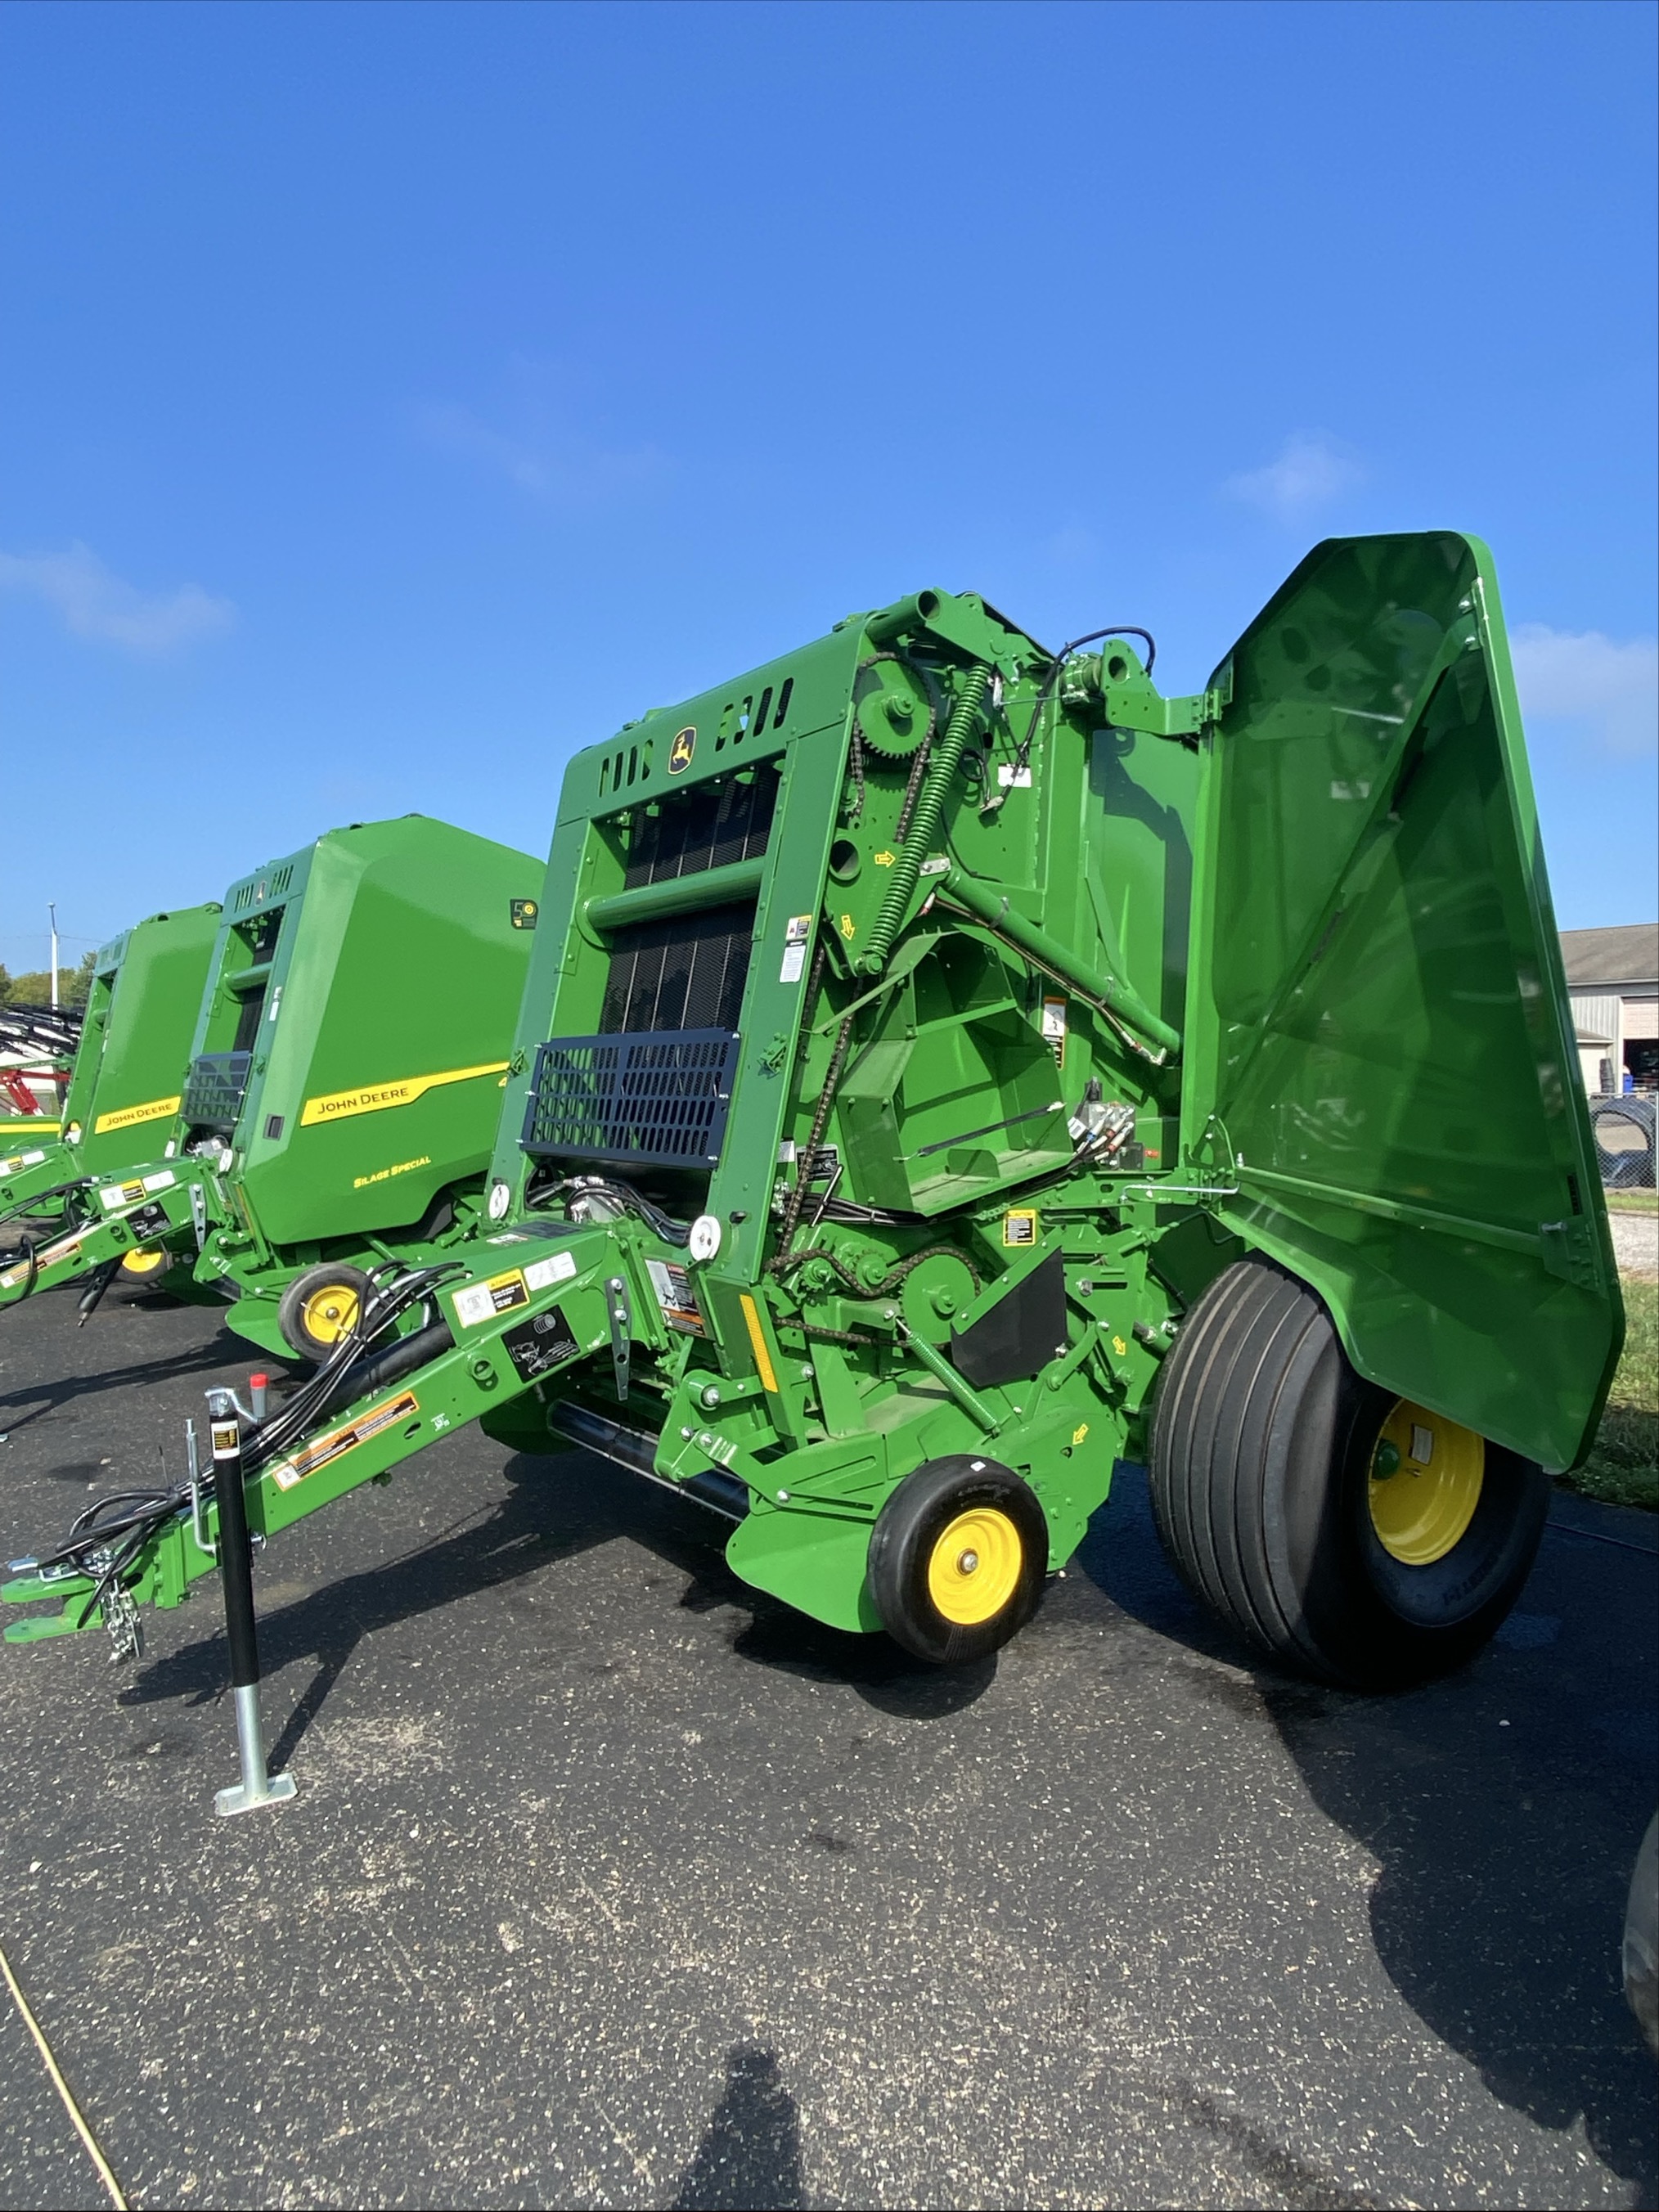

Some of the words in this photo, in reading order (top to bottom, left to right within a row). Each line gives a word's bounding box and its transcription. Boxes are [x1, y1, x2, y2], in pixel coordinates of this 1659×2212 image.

[317, 1099, 357, 1114] JOHN
[360, 1087, 409, 1105] DEERE
[106, 1113, 135, 1126] JOHN
[136, 1104, 173, 1117] DEERE
[353, 1169, 389, 1189] SILAGE
[390, 1156, 432, 1176] SPECIAL
